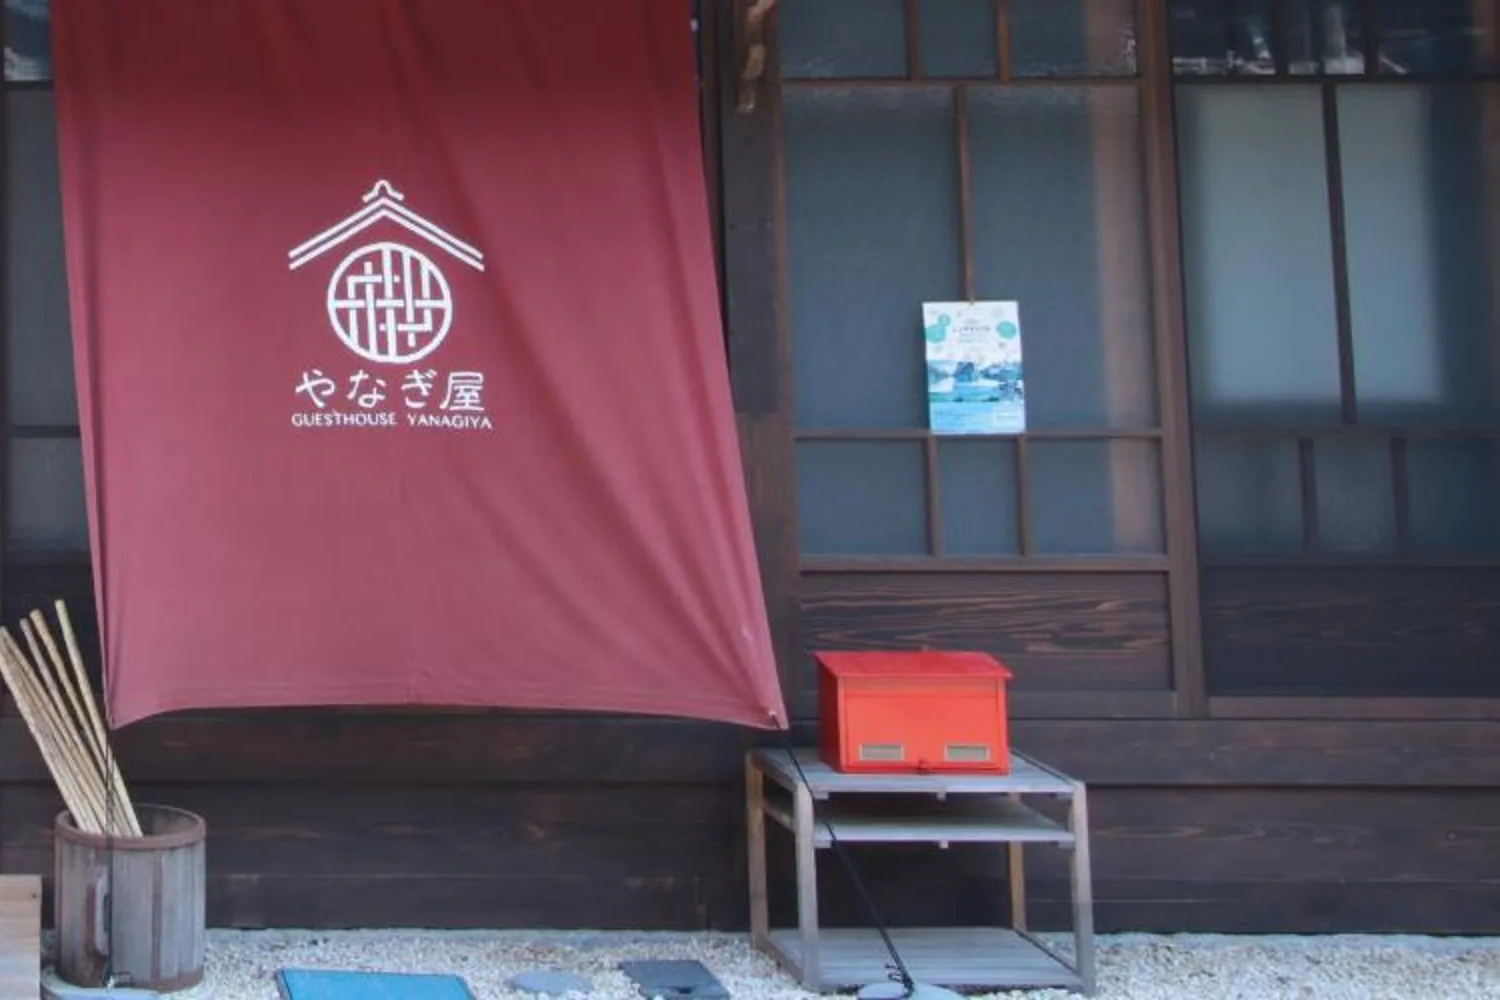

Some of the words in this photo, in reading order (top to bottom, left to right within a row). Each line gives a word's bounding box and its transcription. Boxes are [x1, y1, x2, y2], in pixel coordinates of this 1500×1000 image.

[295, 369, 485, 412] やなぎ屋
[291, 411, 397, 427] GUESTHOUSE
[407, 413, 493, 430] YANAGIYA
